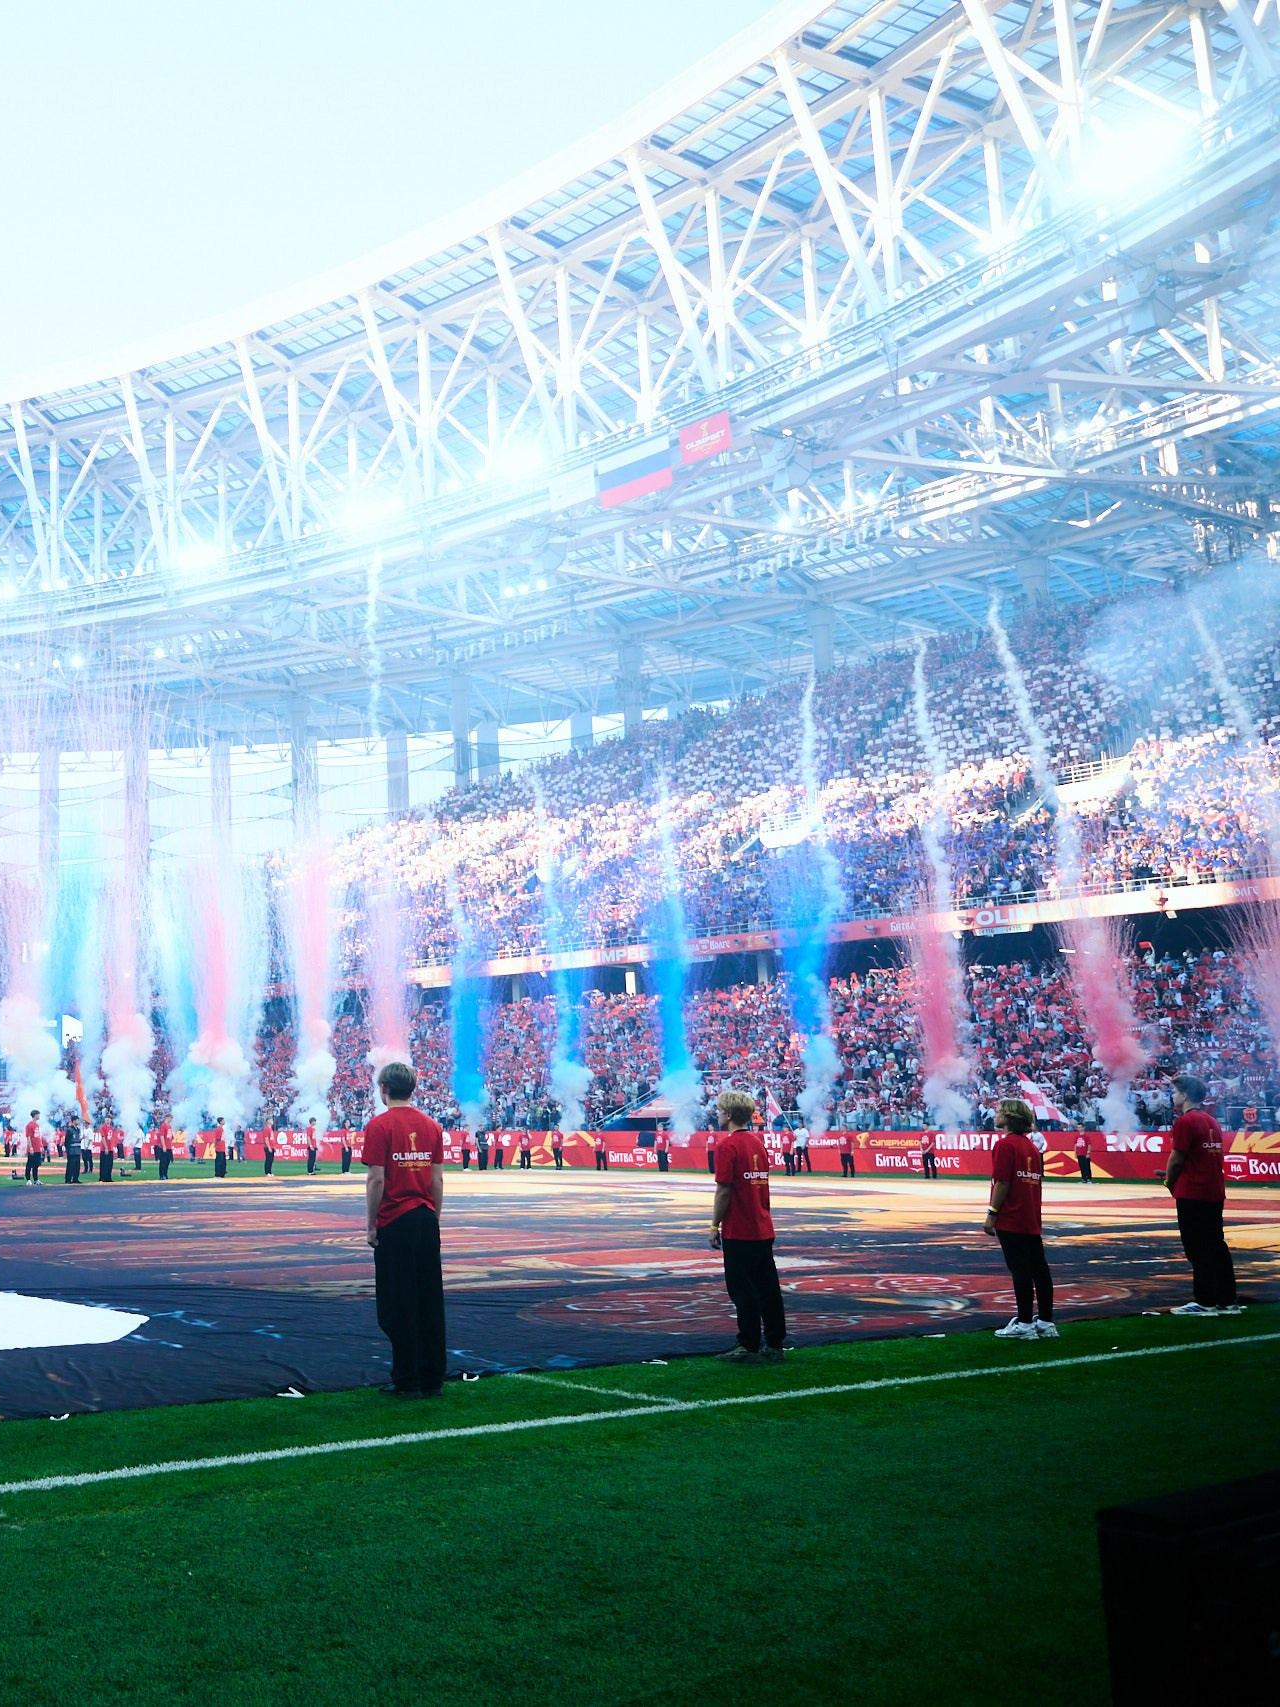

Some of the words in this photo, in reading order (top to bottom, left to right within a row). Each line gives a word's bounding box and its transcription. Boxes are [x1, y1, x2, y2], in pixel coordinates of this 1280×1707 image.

[686, 429, 726, 450] OLIMPBET
[808, 1138, 839, 1146] OLIMP
[869, 1138, 921, 1147] СУПЕРКУБО
[935, 1133, 1006, 1150] СПАРТА
[392, 1151, 433, 1161] OLIMPBE
[927, 1156, 960, 1168] олге
[1248, 1158, 1280, 1175] Вол
